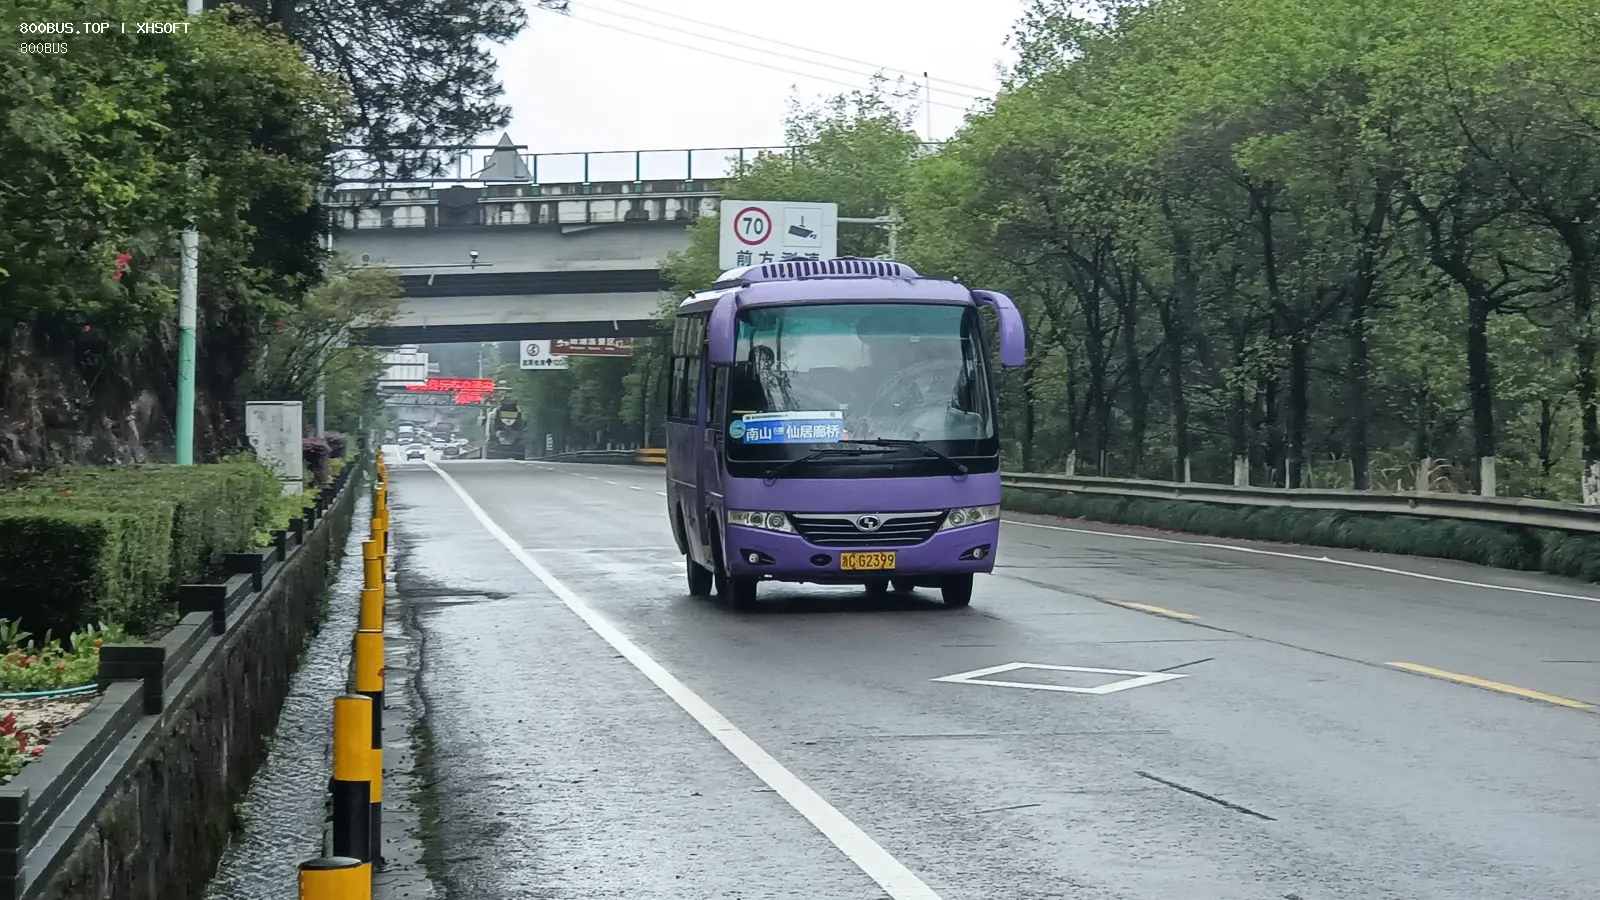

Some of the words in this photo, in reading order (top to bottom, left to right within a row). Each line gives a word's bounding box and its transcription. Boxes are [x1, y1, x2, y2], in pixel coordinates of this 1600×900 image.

[742, 217, 764, 235] 70
[746, 428, 772, 441] 南山
[786, 424, 840, 439] 仙居廊桥
